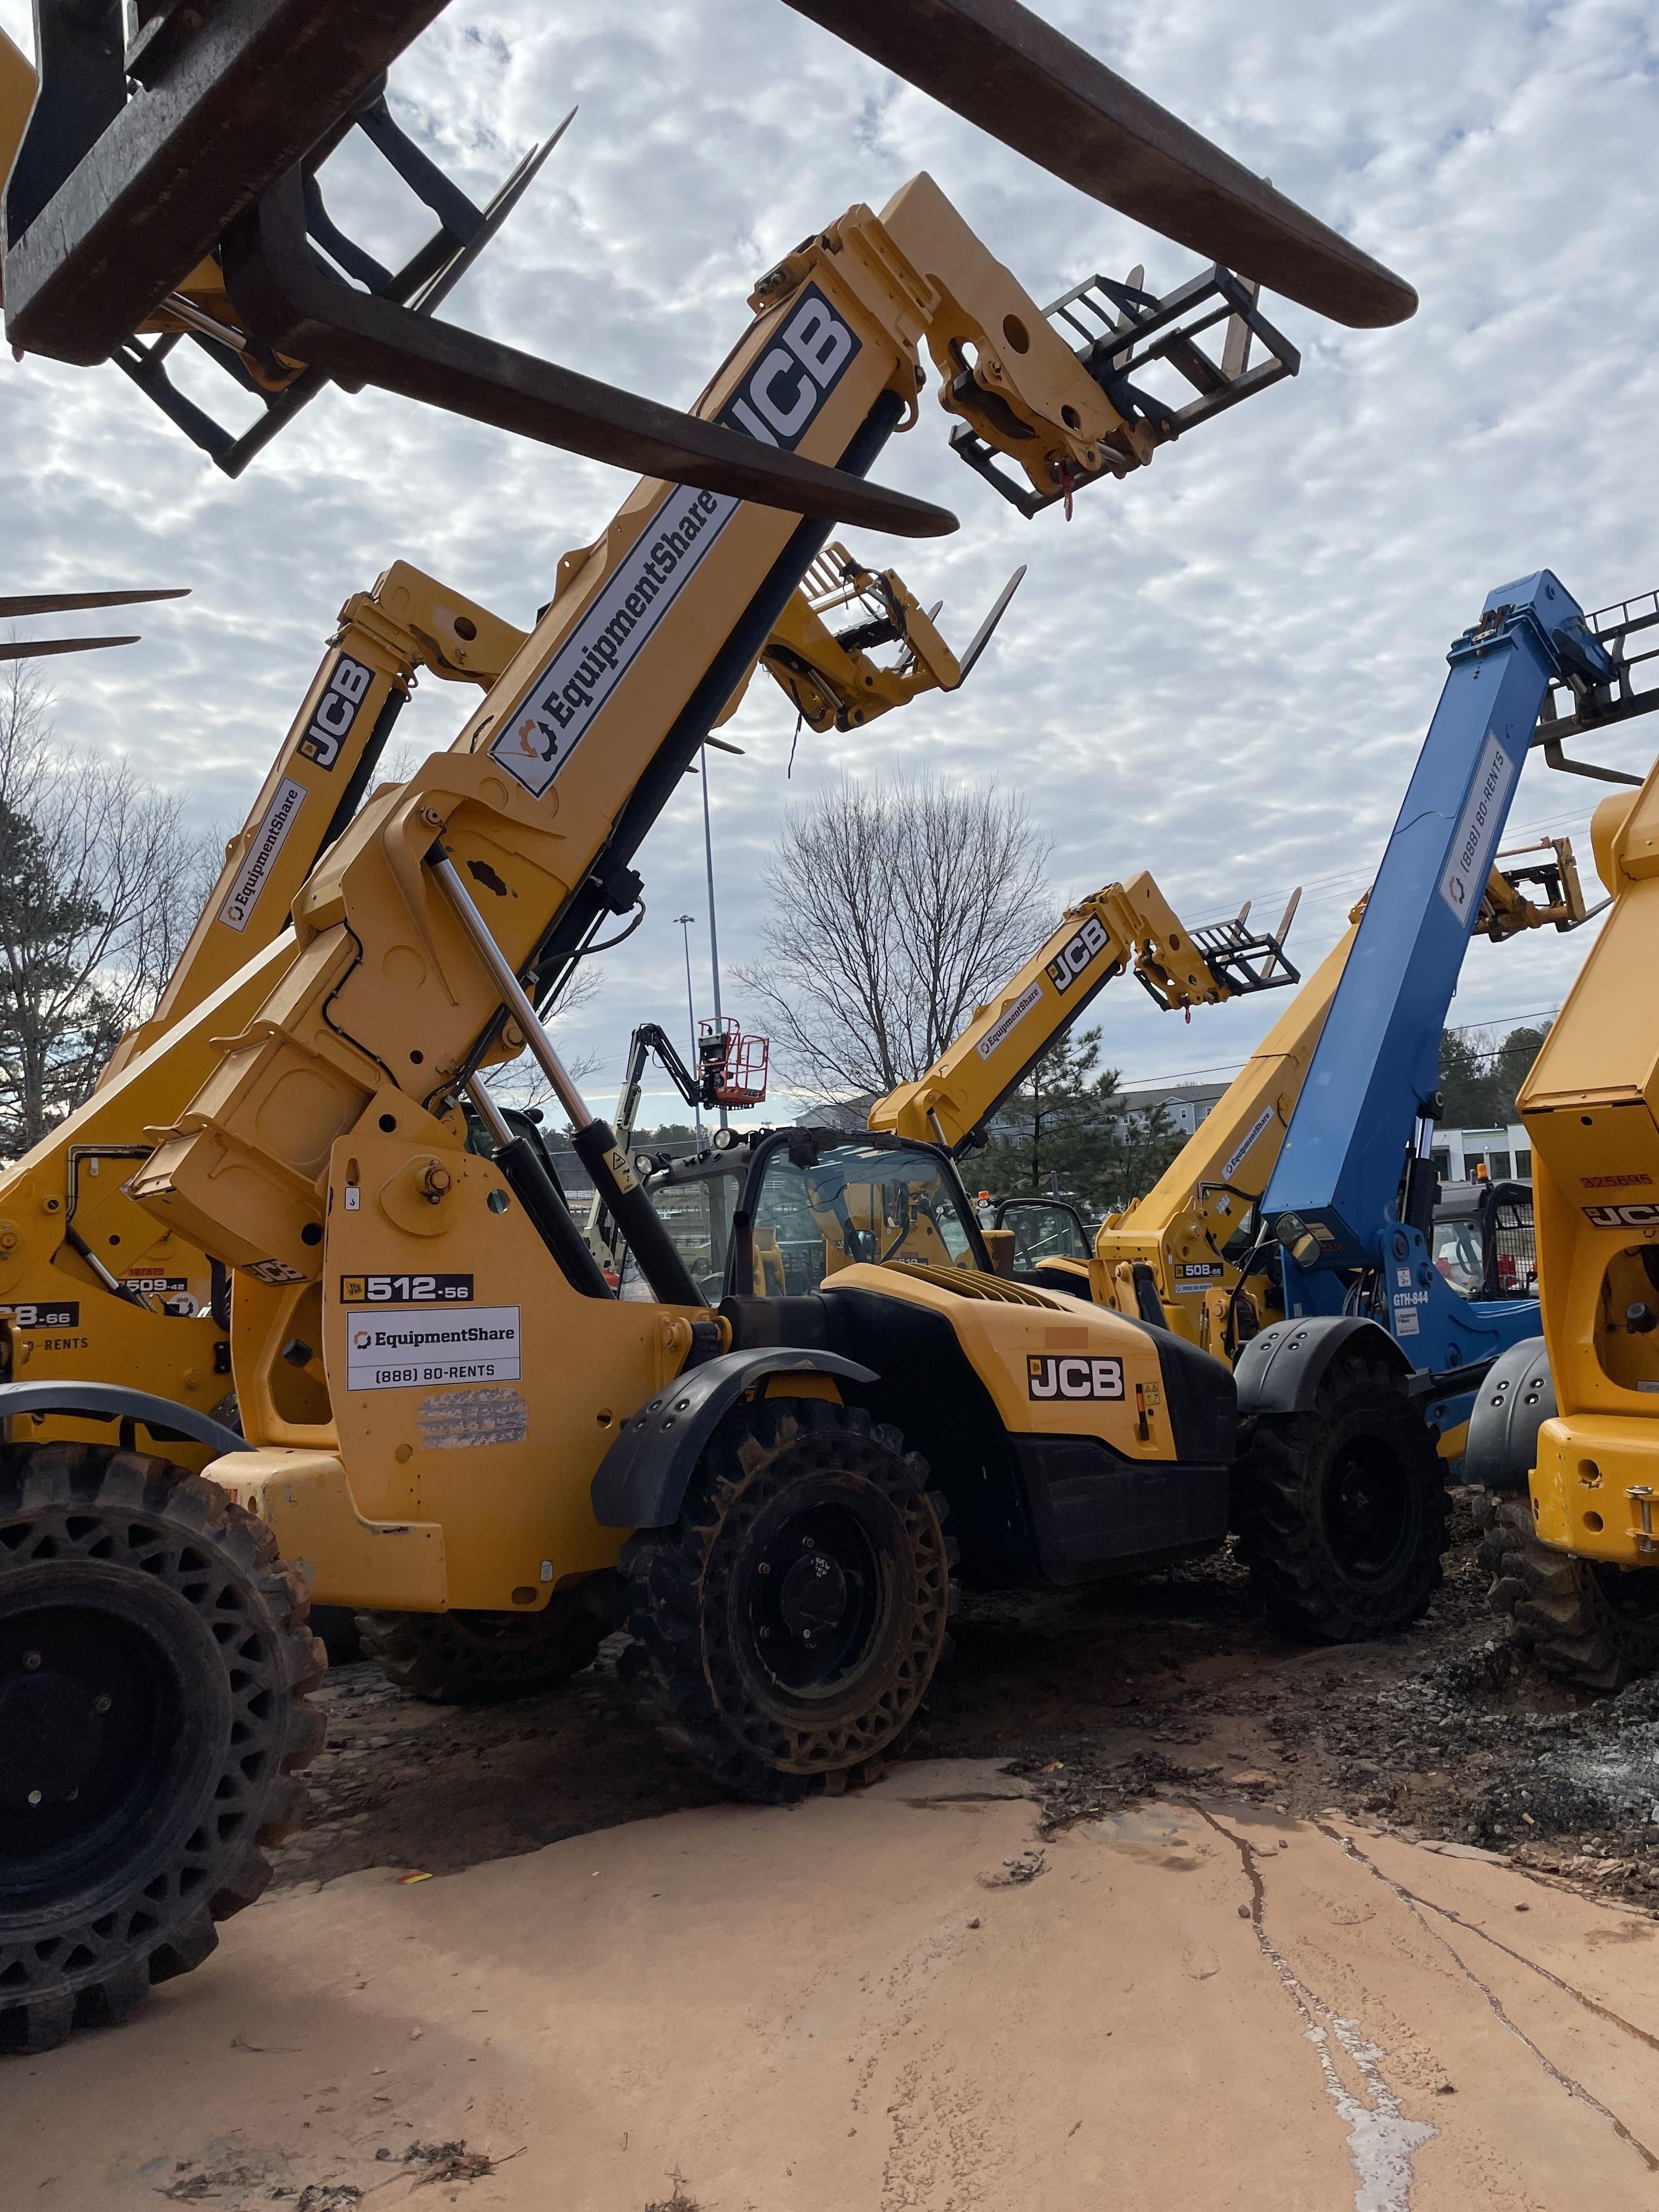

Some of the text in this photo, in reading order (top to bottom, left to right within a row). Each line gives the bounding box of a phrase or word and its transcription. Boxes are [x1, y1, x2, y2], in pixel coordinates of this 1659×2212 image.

[541, 489, 718, 729] EquipmentShare
[309, 659, 370, 766] JCB
[1460, 751, 1504, 873] (888) 80-RENTS
[235, 789, 298, 906] EquipmentShare
[1055, 918, 1108, 990] JCB
[987, 988, 1039, 1046] EquipmentShare
[742, 1089, 760, 1098] JLG
[1231, 1112, 1270, 1167] EquipmentShare
[1592, 1205, 1659, 1226] JC
[126, 1279, 185, 1293] 509-42
[252, 1261, 303, 1283] JCB
[367, 1277, 469, 1301] 512-56
[27, 1338, 88, 1352] 0-RENTS
[375, 1328, 515, 1348] EquipmentShare
[376, 1365, 495, 1384] (888) 80-RENTS
[1031, 1359, 1123, 1397] JCB
